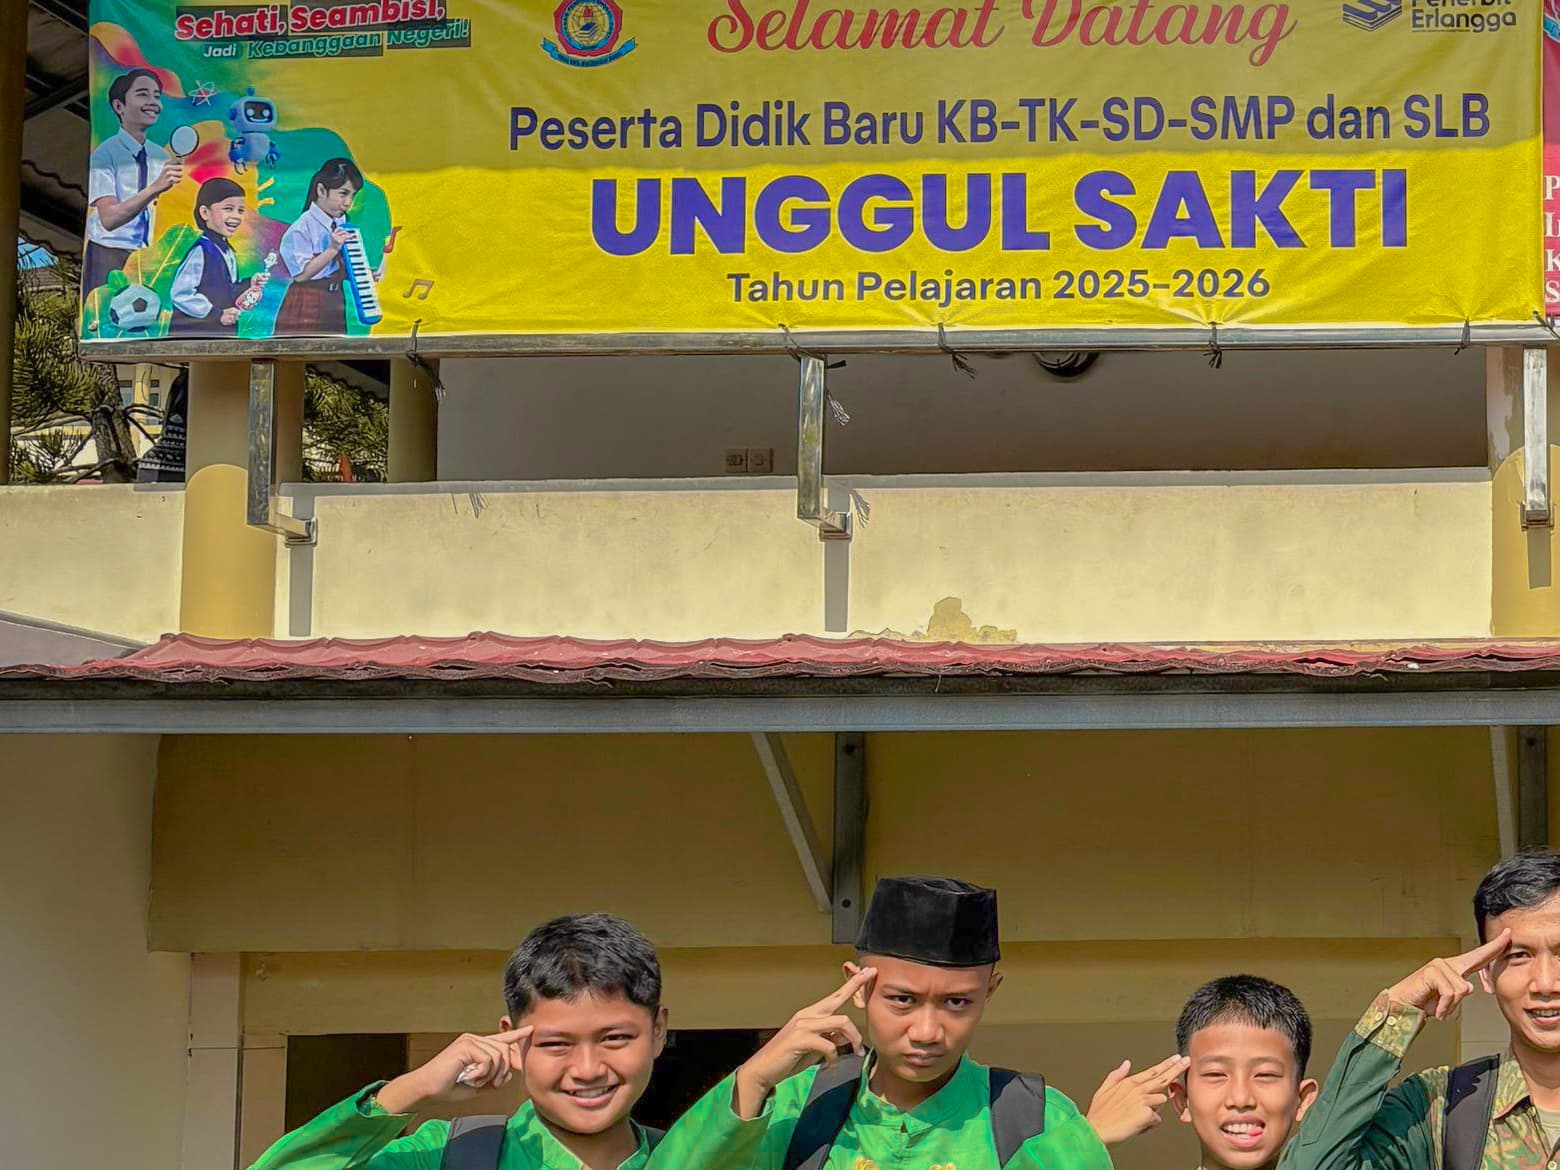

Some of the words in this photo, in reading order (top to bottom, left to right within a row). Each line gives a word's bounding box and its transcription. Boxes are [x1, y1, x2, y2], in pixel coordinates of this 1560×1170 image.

[175, 6, 285, 40] Sehati,
[204, 43, 236, 58] Jadi
[248, 33, 381, 59] Kebanggaan
[386, 20, 470, 47] Negeri!
[707, 0, 1004, 53] Selamat
[1022, 0, 1298, 67] Datang
[1412, 8, 1517, 33] Erlangga
[510, 106, 682, 151] Peserta
[697, 101, 810, 147] Didik
[825, 102, 923, 145] Baru
[938, 95, 1294, 143] KB-TK-SD-SMP
[1307, 94, 1390, 140] dan
[1404, 93, 1490, 139] SLB
[592, 173, 1050, 256] UNGGUL
[1074, 169, 1407, 251] SAKTI
[727, 273, 843, 302] Tahun
[856, 270, 1041, 307] Pelajaran
[1053, 269, 1270, 299] 2025-2026
